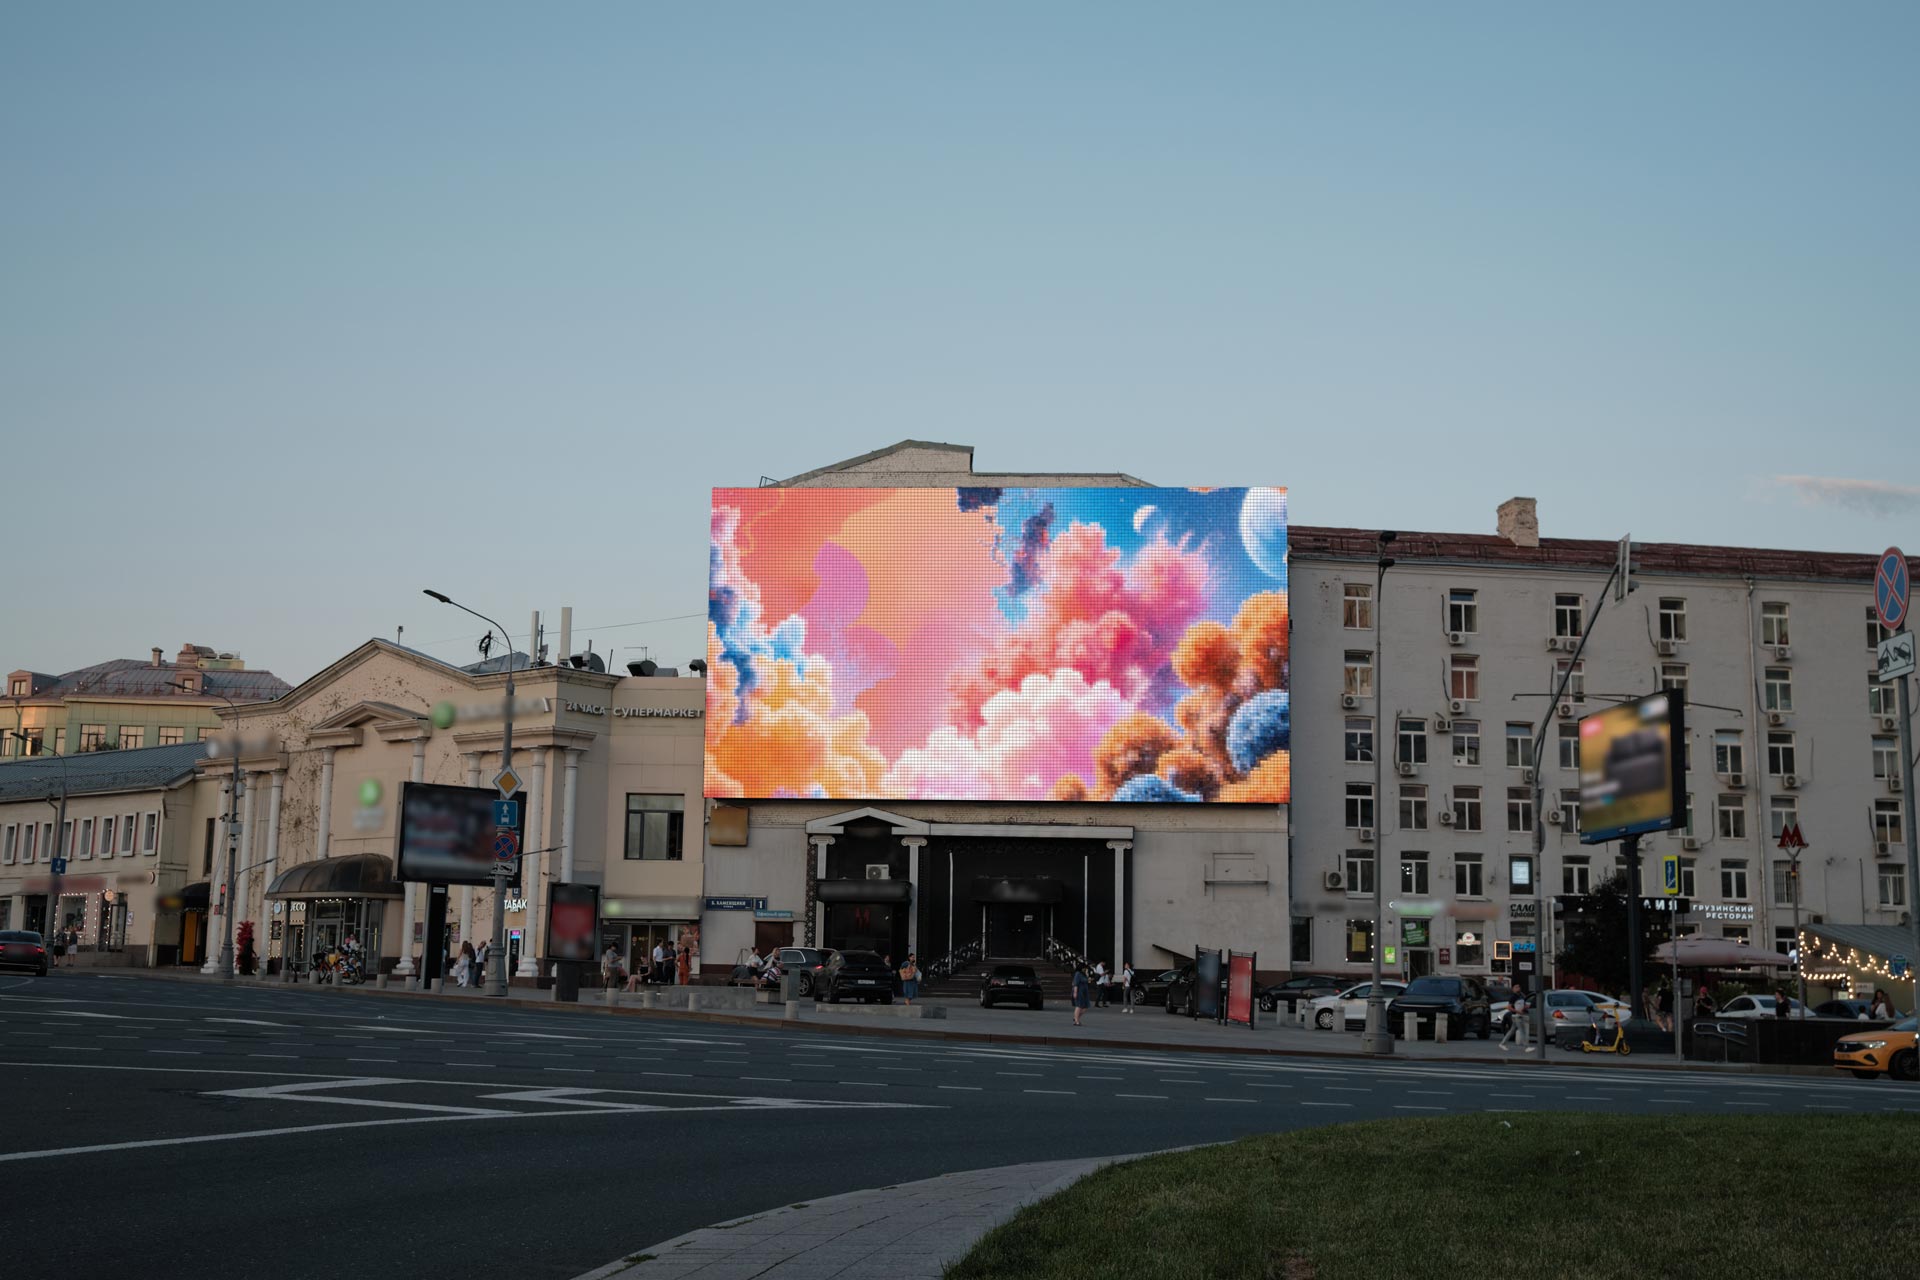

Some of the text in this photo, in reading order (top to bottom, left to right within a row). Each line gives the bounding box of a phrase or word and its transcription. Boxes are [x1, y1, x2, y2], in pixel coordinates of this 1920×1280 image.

[566, 701, 703, 719] 24 ЧАСА СУПЕРМАРКЕТ
[504, 899, 527, 910] ТАБАК
[758, 901, 763, 909] 1
[1510, 903, 1535, 912] САЛО
[1692, 904, 1754, 912] ГРУЗИНСКИЙ
[1705, 912, 1754, 920] РЕСТОРАН
